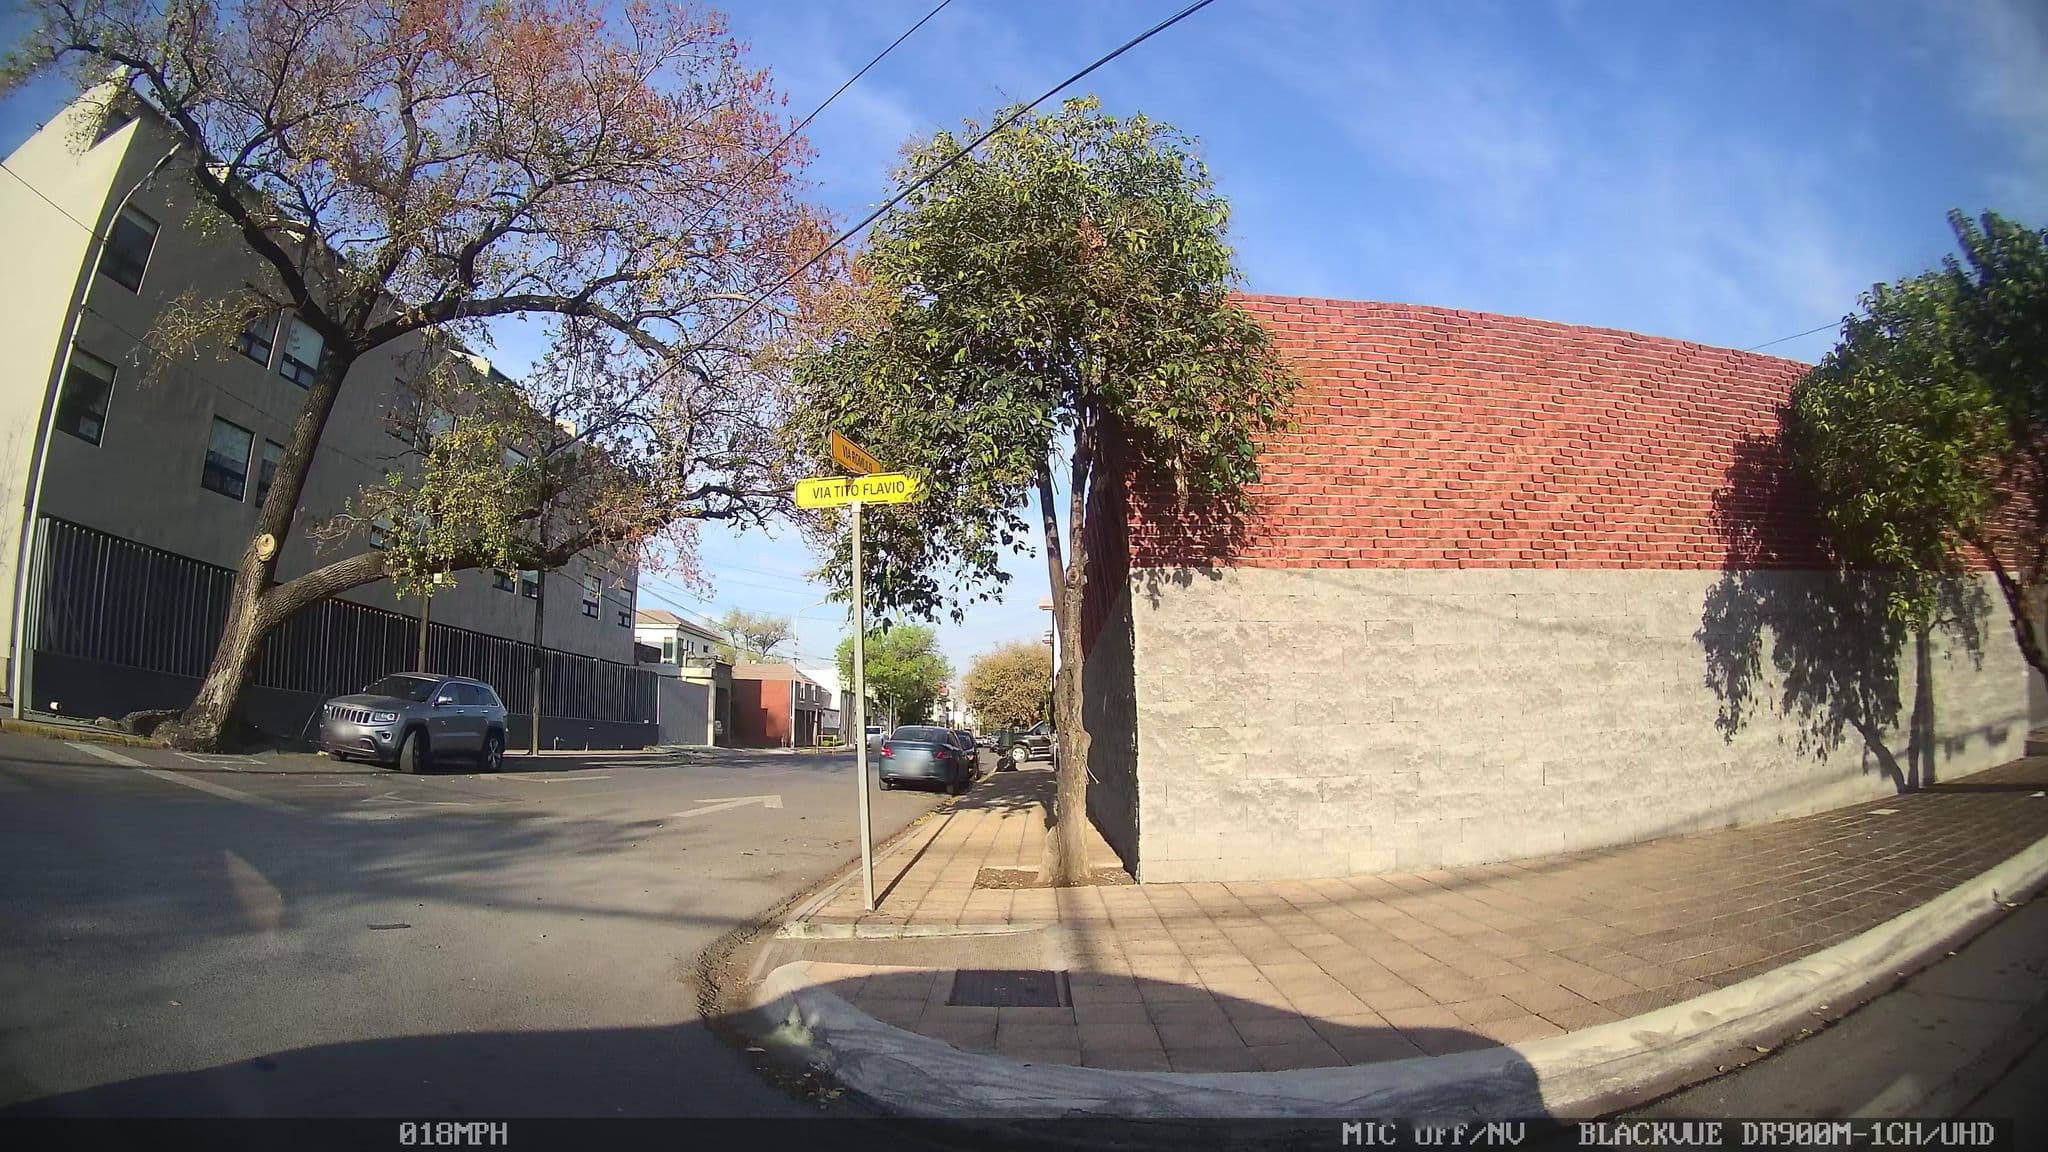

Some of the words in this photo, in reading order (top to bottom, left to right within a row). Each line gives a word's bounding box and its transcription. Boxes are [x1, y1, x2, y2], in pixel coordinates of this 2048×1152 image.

[812, 486, 832, 499] VIA
[834, 484, 859, 497] TITO
[863, 481, 905, 495] FLAVIO
